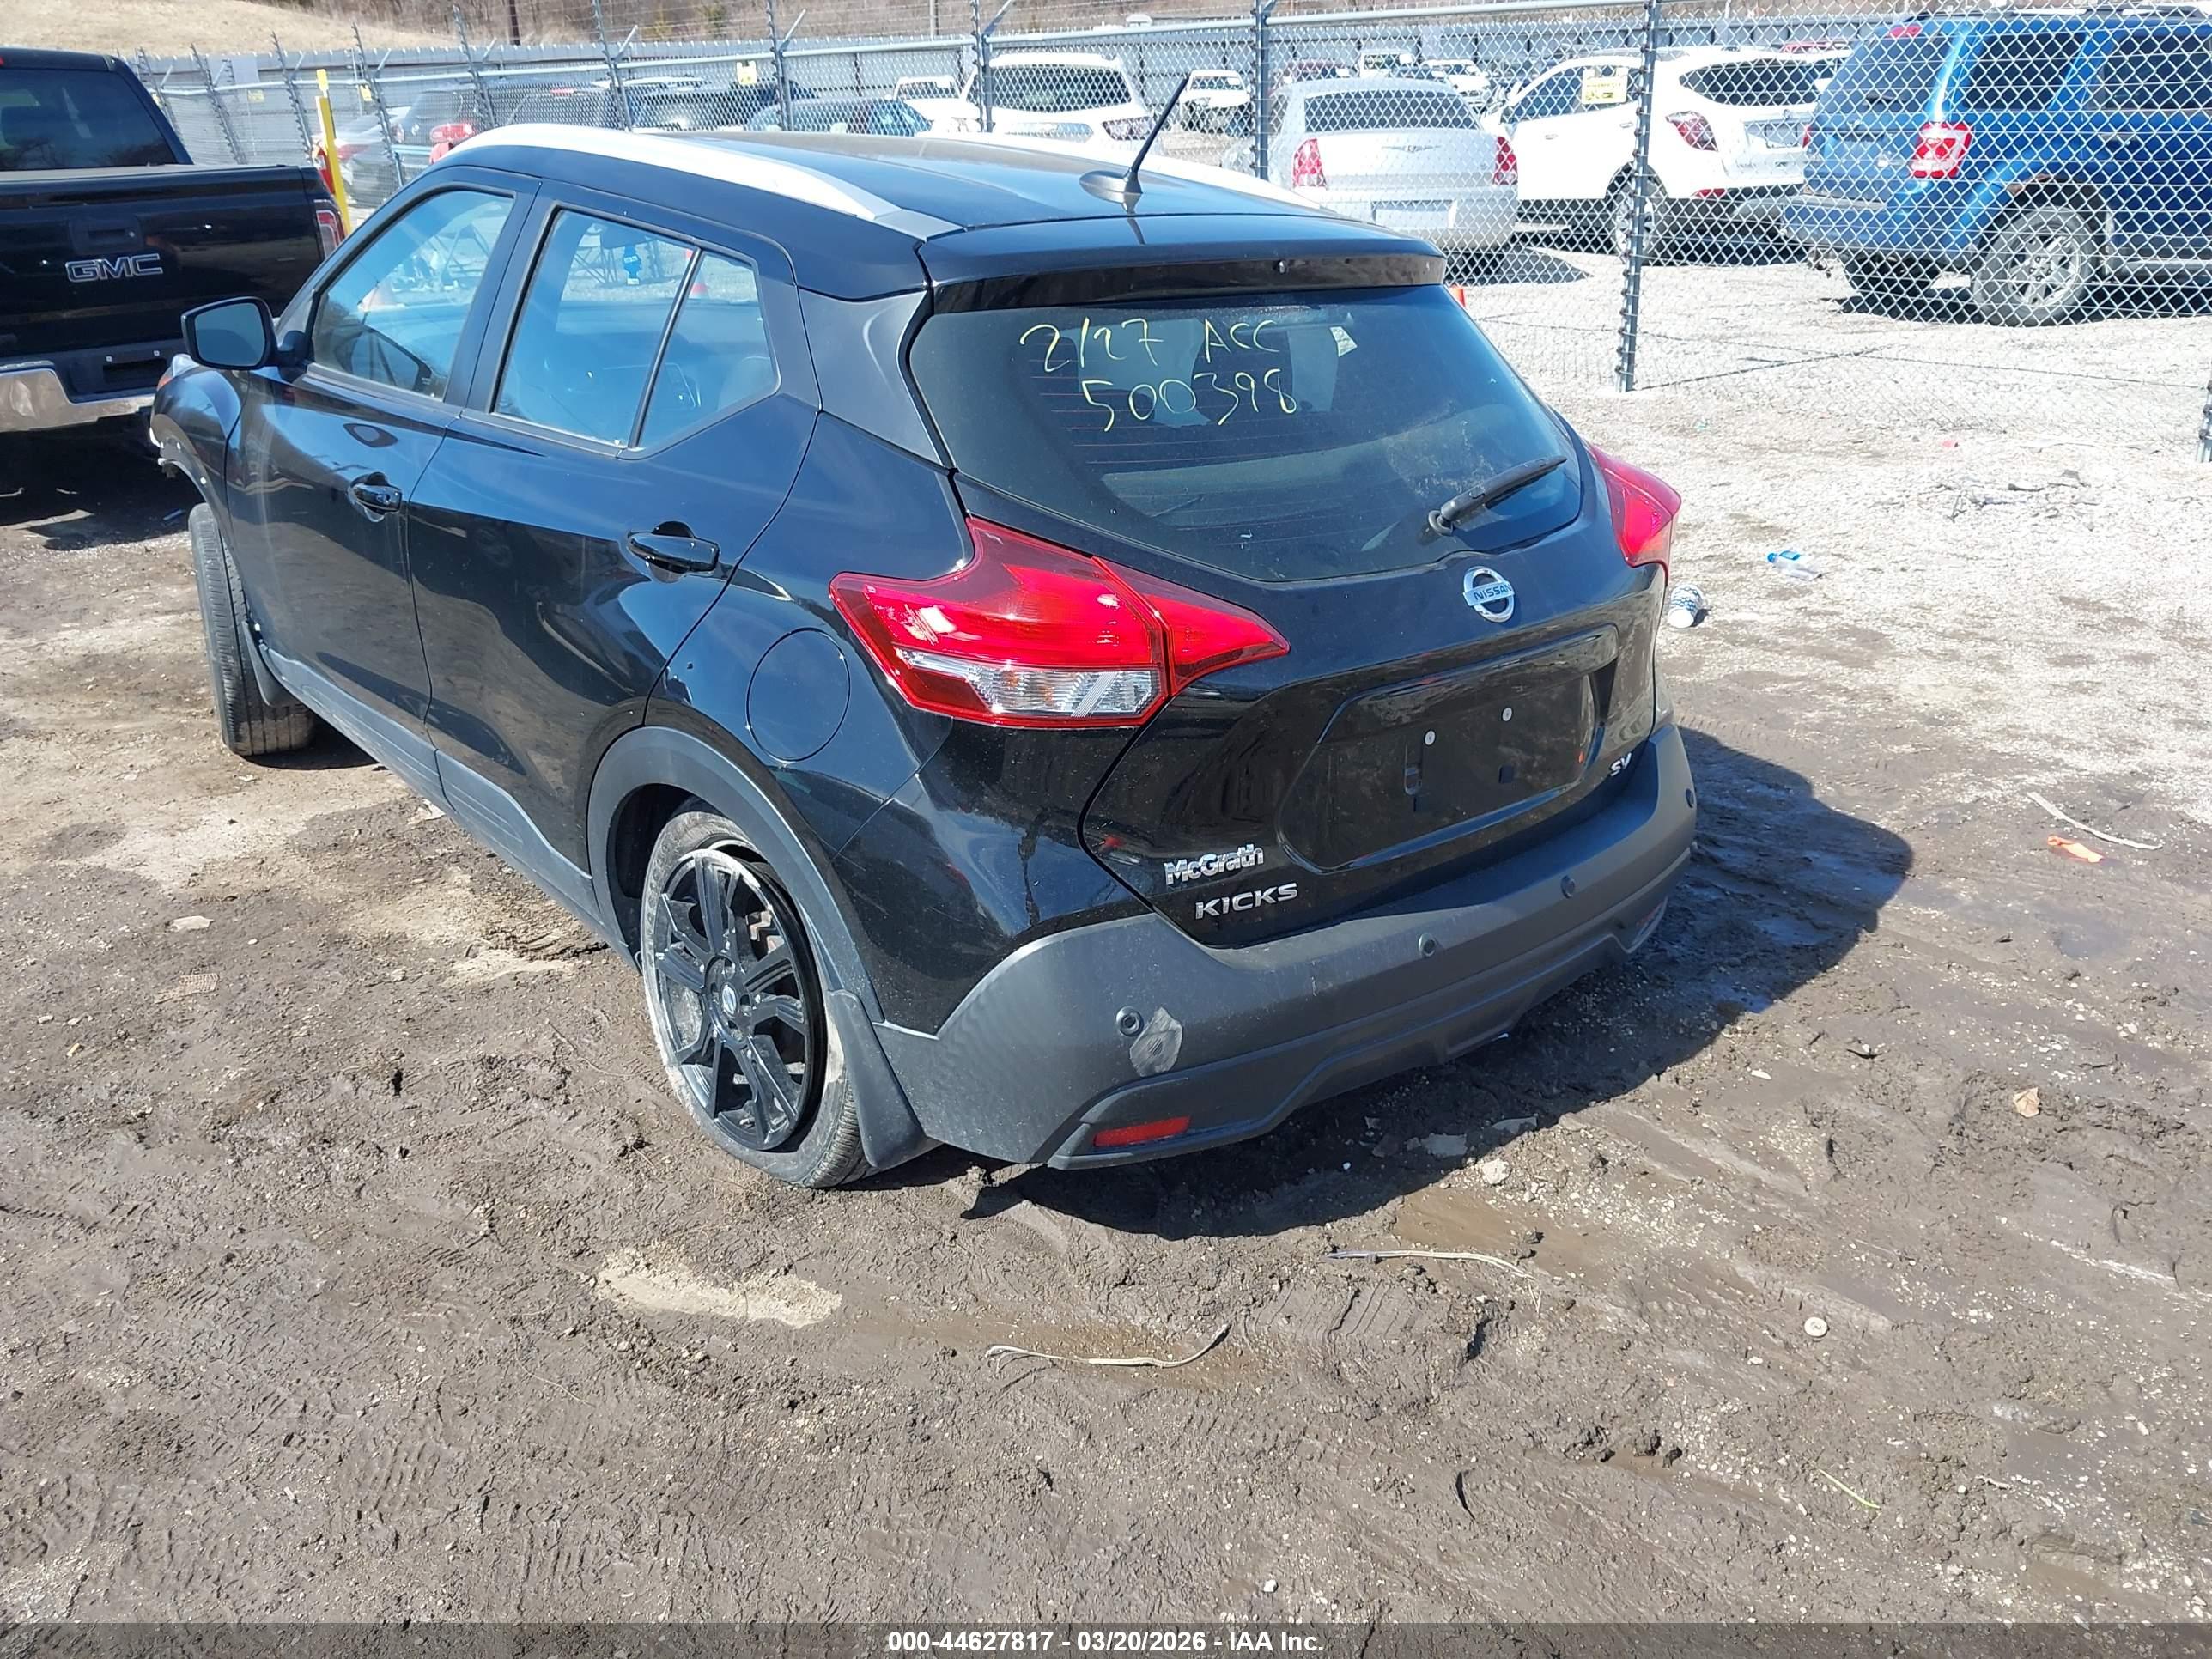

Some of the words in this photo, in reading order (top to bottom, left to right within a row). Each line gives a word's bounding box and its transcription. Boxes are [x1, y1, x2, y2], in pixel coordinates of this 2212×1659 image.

[65, 253, 163, 282] GMC
[1019, 317, 1164, 372] 2/27
[1206, 319, 1280, 363] ACC
[1081, 368, 1297, 431] 500398
[1474, 585, 1512, 601] NISSAN
[1609, 753, 1632, 776] SV
[1164, 843, 1265, 886] McGrath
[1194, 883, 1298, 920] KICKS
